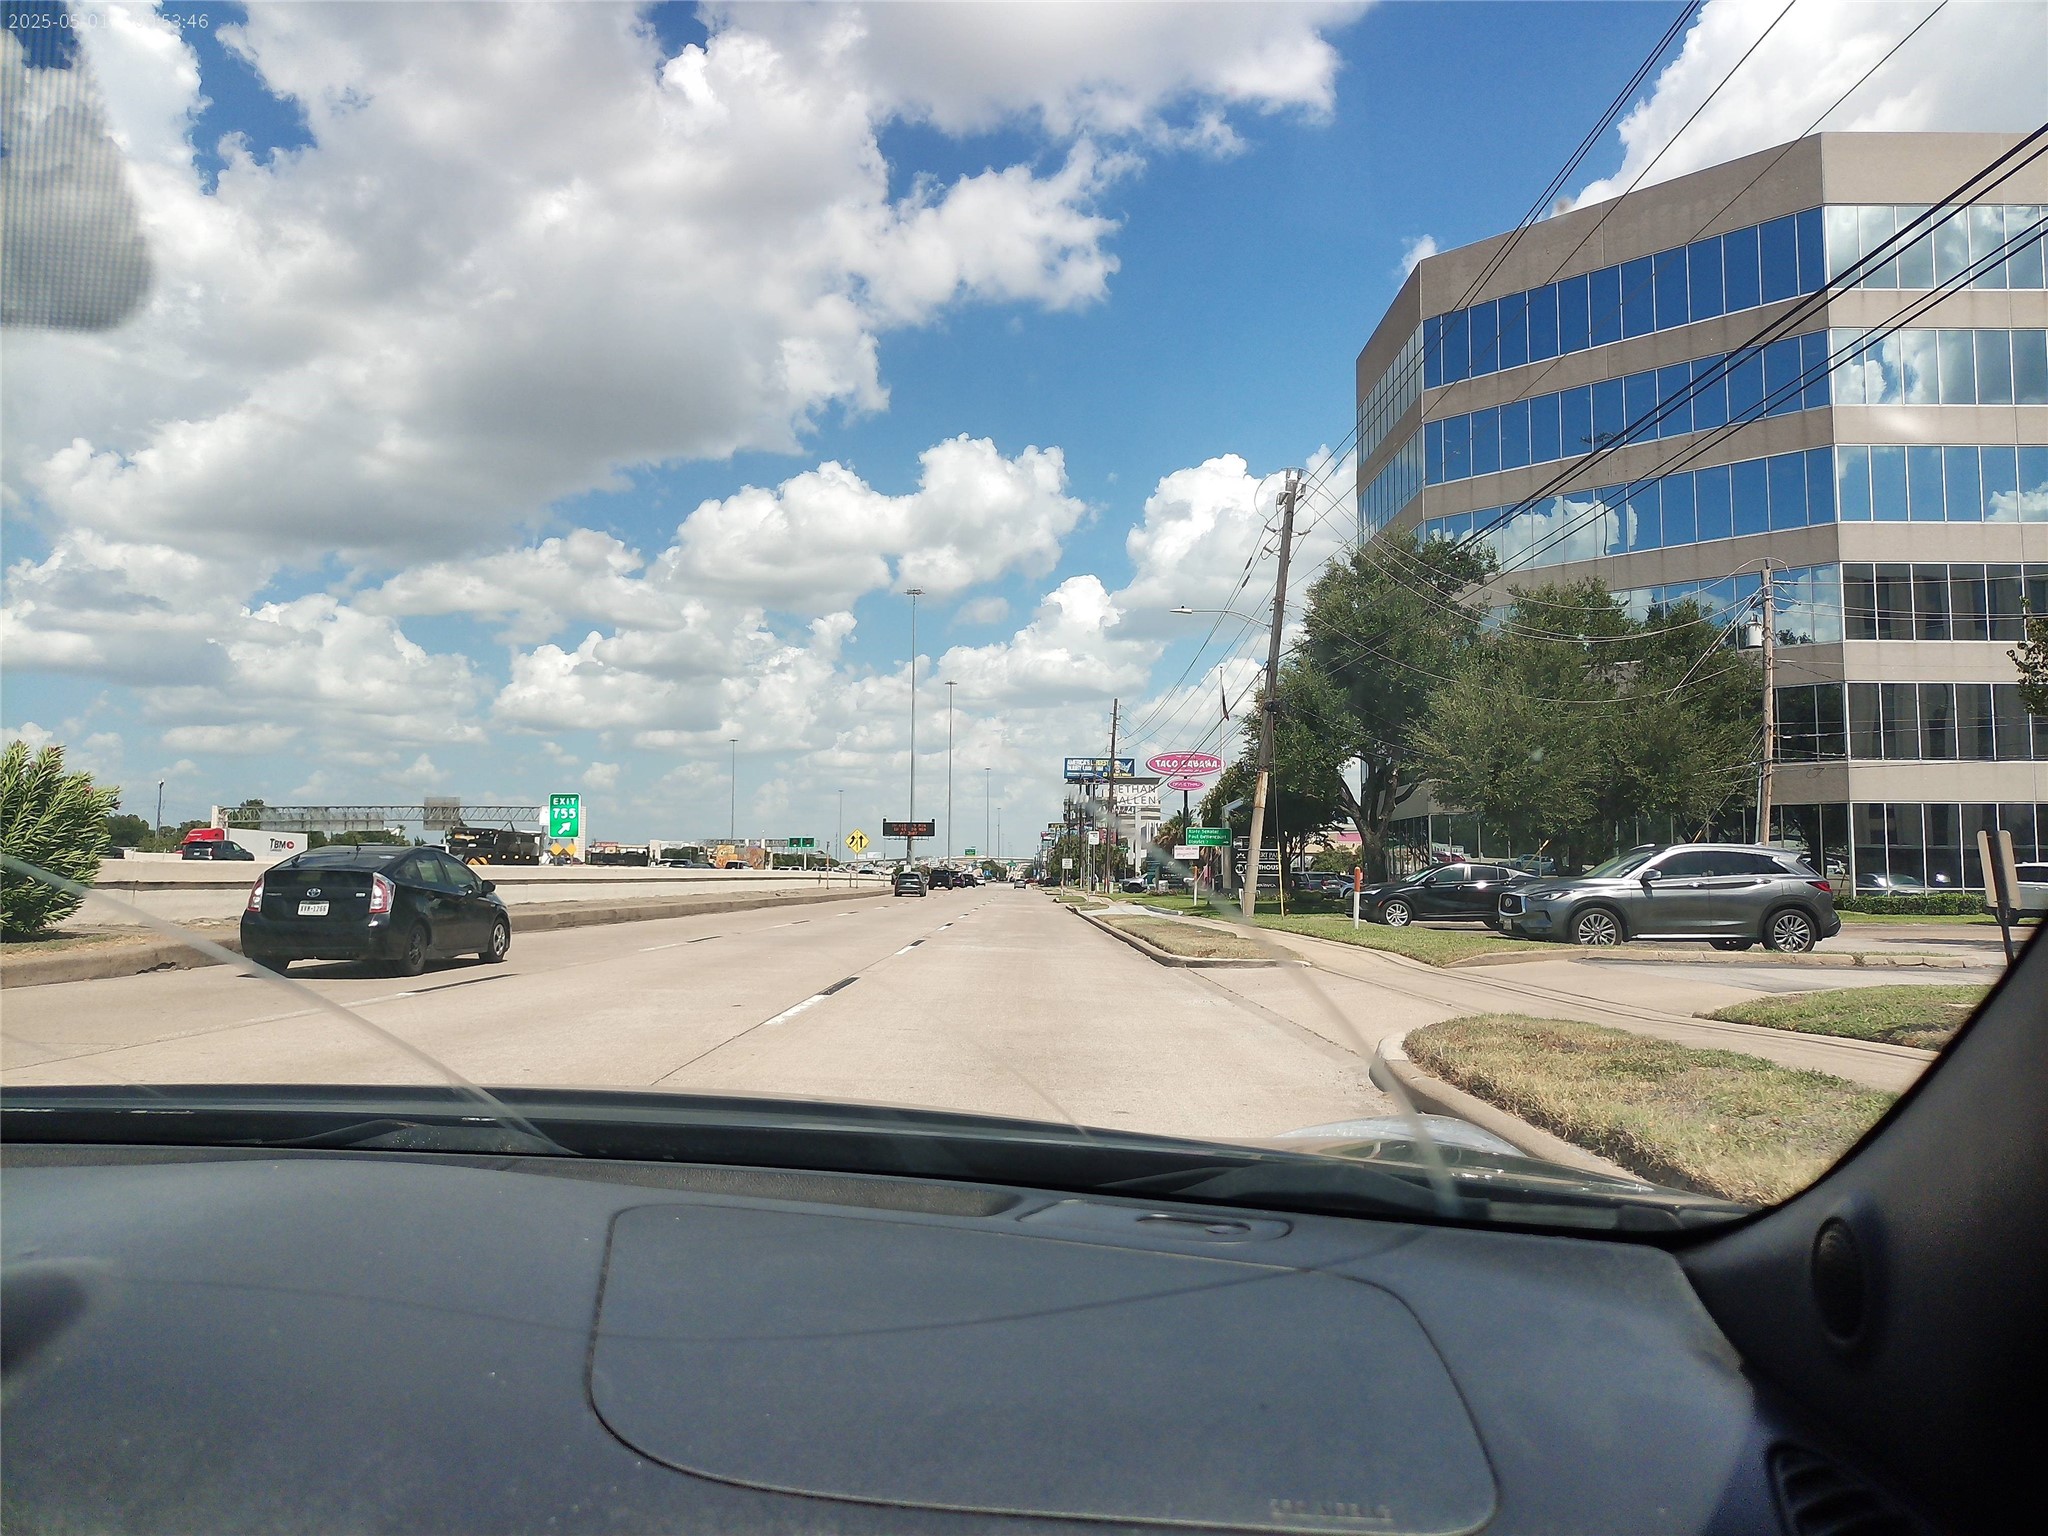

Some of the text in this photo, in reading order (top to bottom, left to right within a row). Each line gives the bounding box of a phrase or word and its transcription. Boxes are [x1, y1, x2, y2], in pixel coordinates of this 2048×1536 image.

[1155, 760, 1179, 768] TACO
[1118, 784, 1156, 794] ETHAN
[552, 797, 576, 805] EXIT
[1118, 795, 1156, 805] ALLEN
[552, 808, 577, 819] 755
[269, 838, 286, 849] TBM
